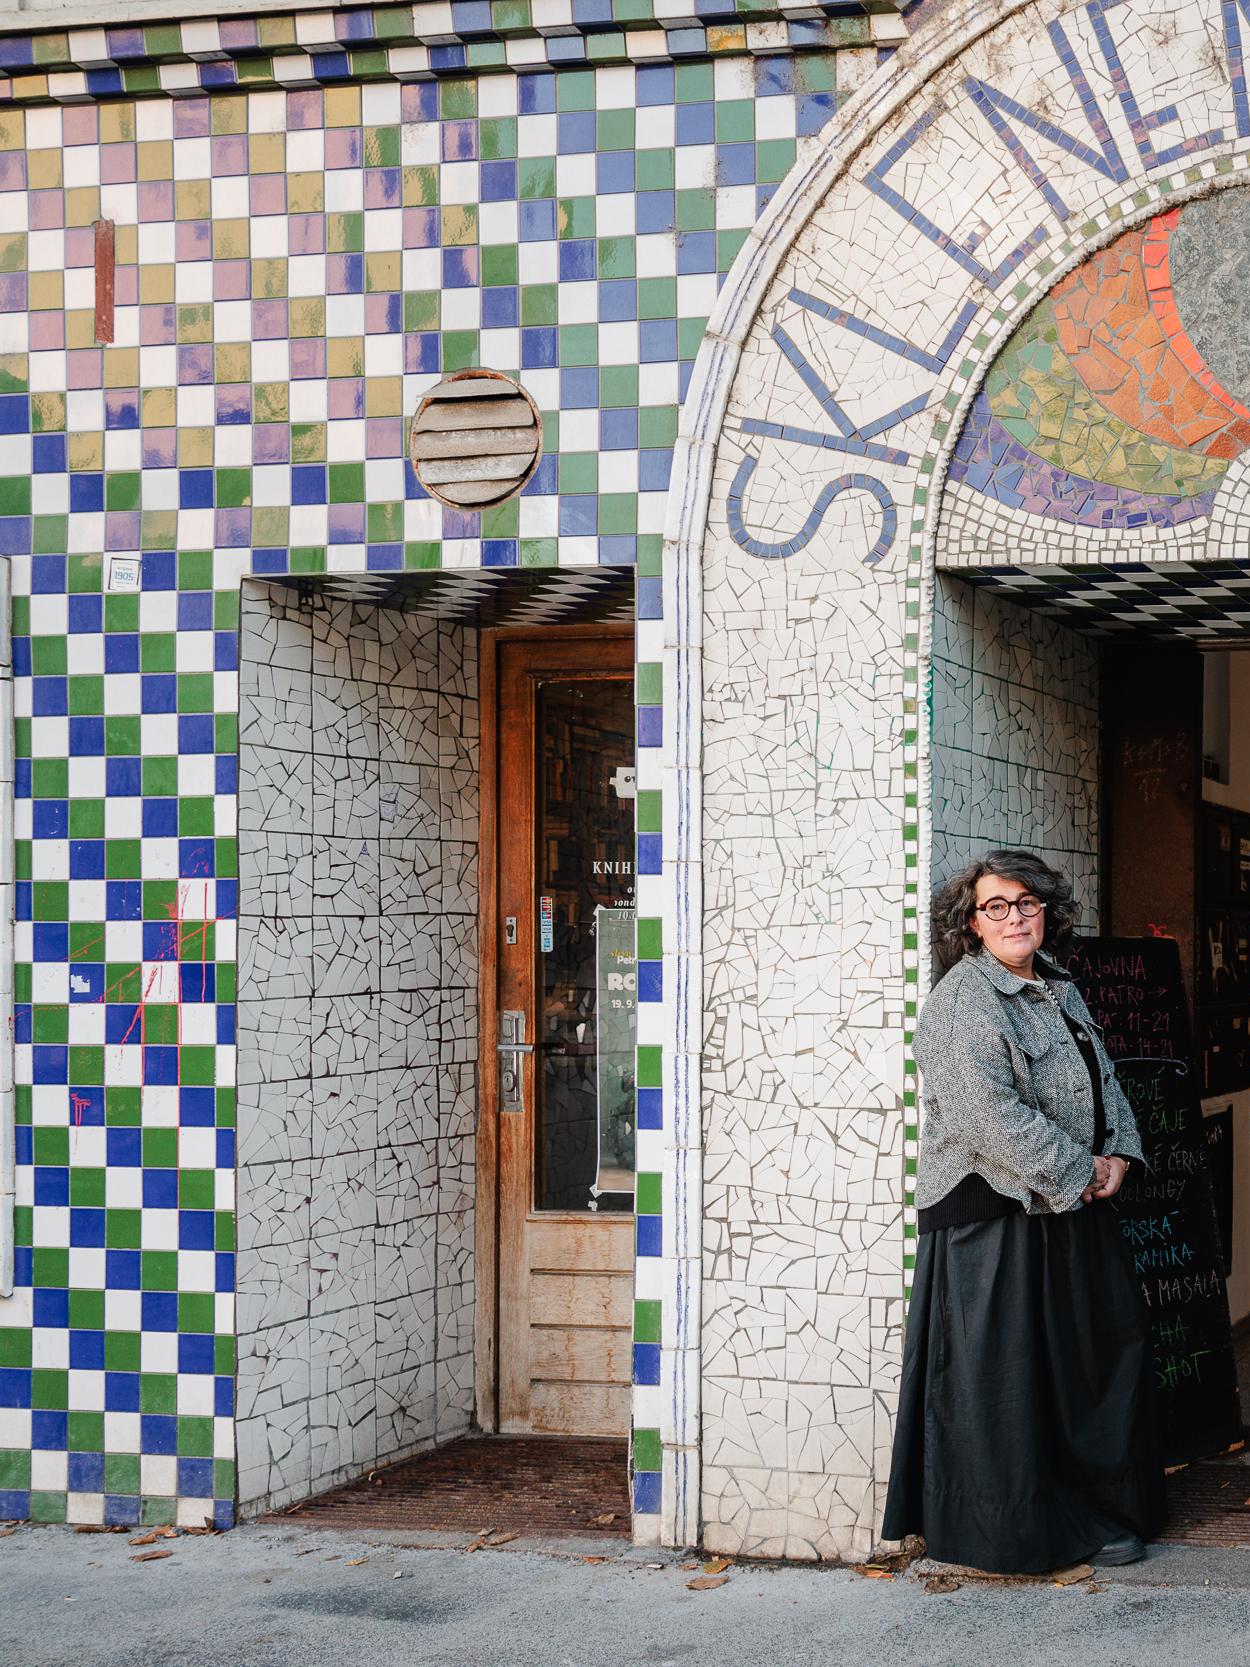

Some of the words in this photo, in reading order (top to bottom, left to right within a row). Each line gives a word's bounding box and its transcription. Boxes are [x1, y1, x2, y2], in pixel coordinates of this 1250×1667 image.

[115, 570, 135, 582] 1905
[592, 861, 636, 875] KNIH
[1066, 944, 1149, 981] ČAJOVNA
[1134, 1242, 1196, 1275] RAMIKA
